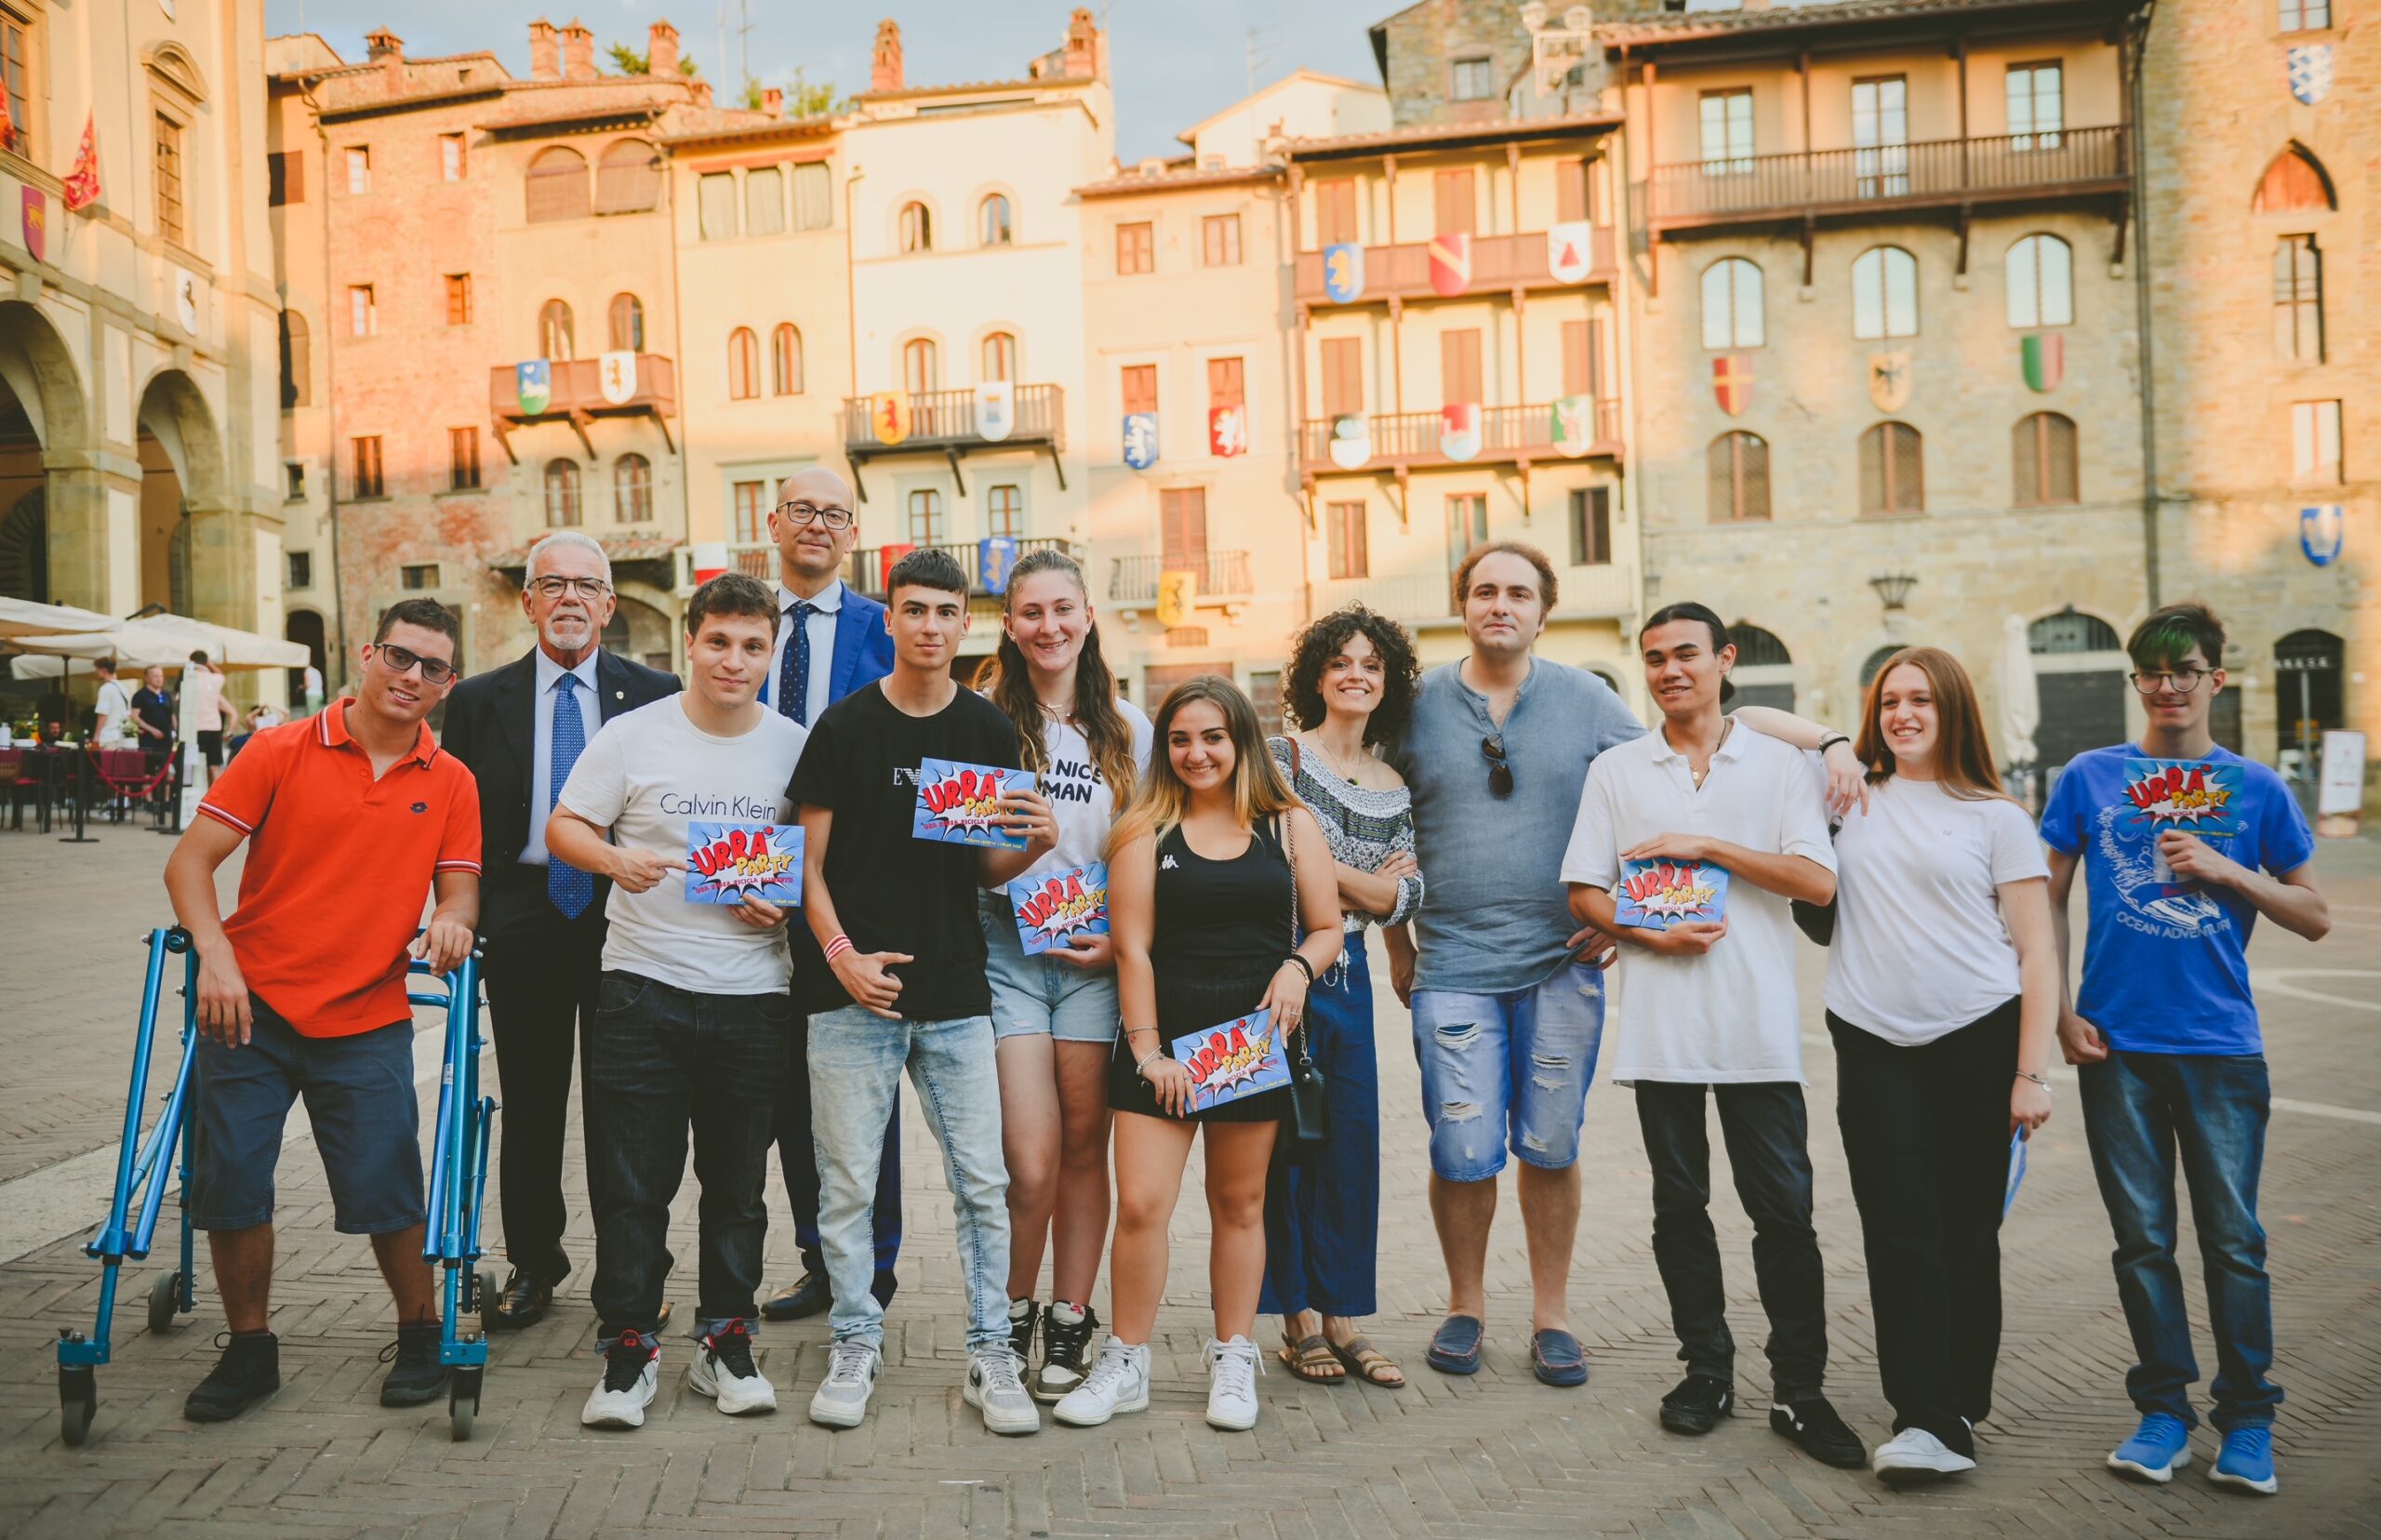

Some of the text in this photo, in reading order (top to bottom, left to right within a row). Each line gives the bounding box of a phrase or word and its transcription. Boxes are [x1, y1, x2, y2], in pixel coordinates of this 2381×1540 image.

[1034, 779, 1093, 803] MAN
[2171, 790, 2232, 809] PARTY
[660, 792, 777, 821] Calvin Klein
[964, 797, 1016, 817] PAR
[736, 854, 795, 876] PARTY
[1057, 889, 1107, 921] PARTY
[1663, 886, 1717, 905] PARTY
[2116, 910, 2232, 939] OCEAN ADVENTUR
[1220, 1038, 1272, 1075] PARTY
